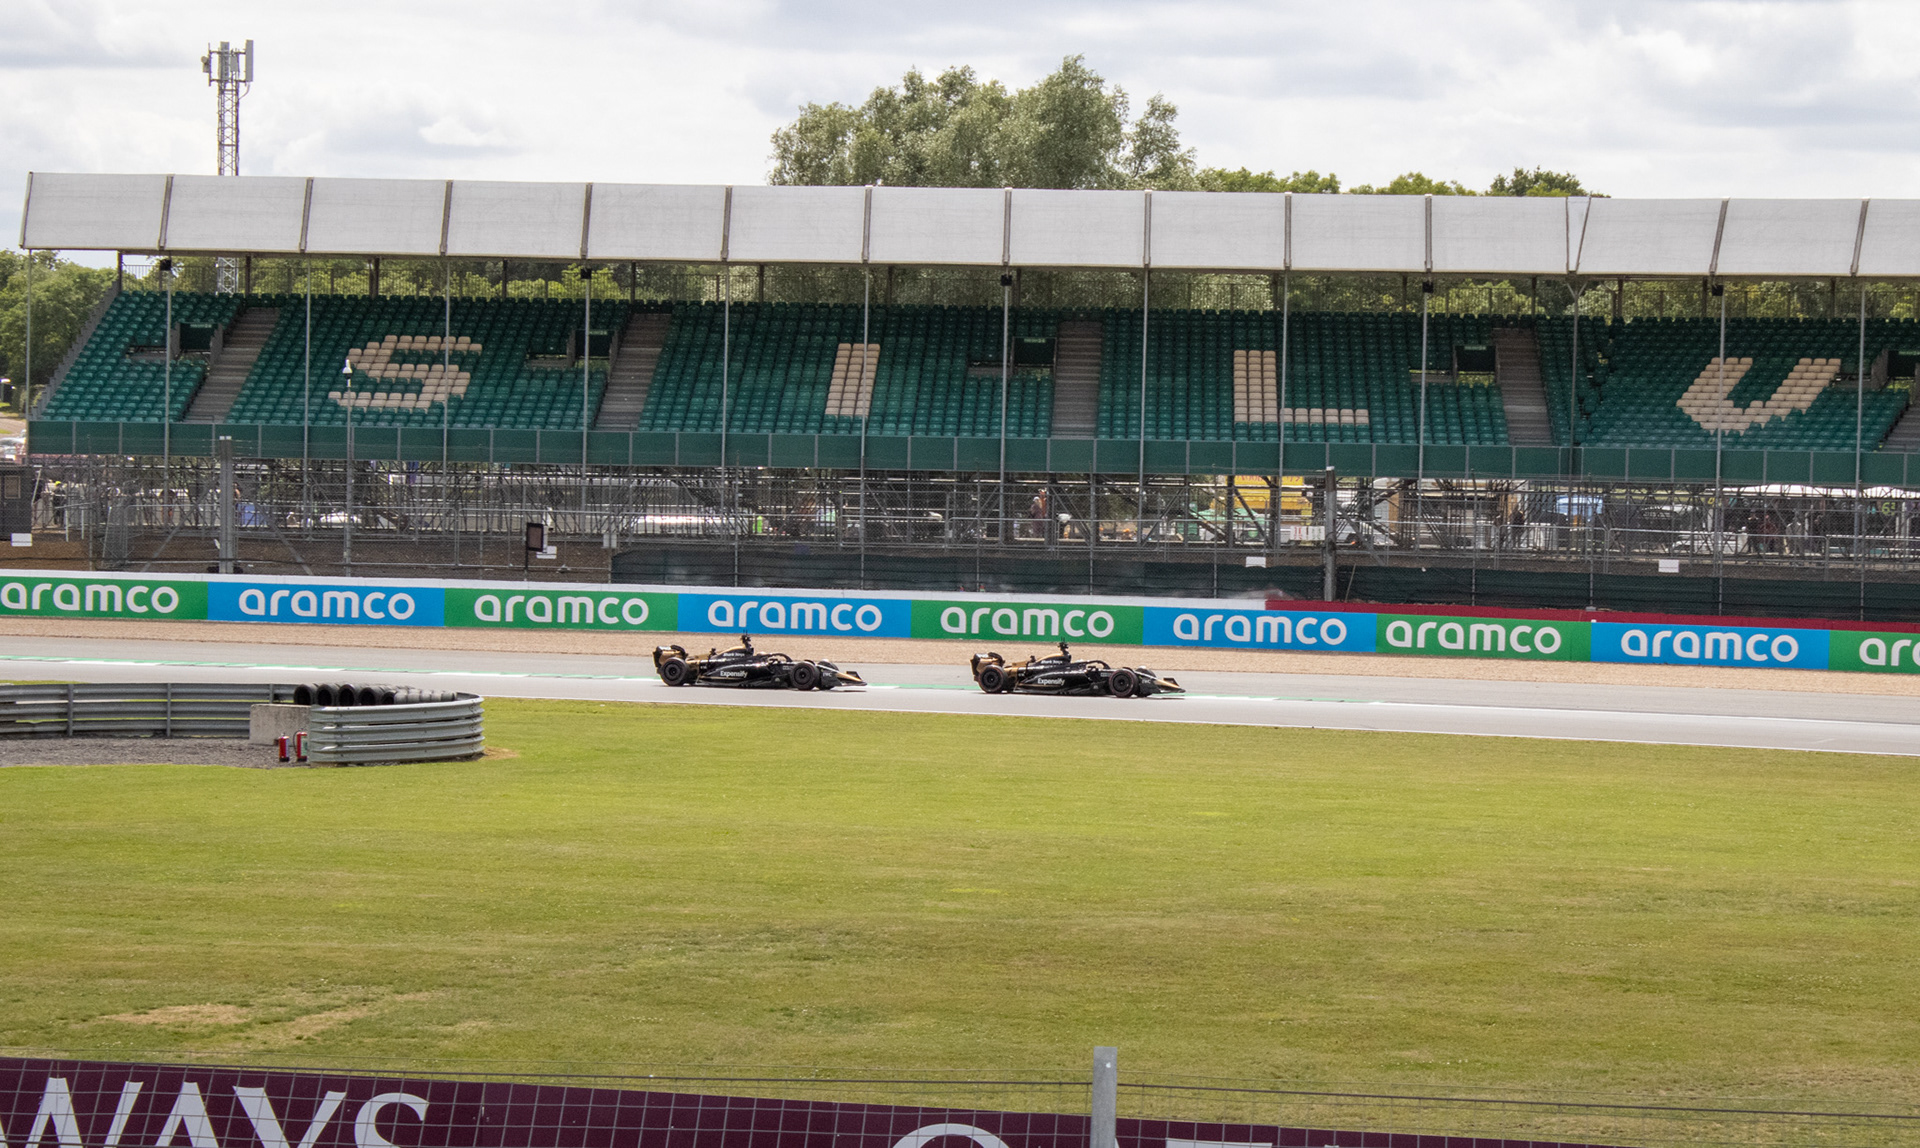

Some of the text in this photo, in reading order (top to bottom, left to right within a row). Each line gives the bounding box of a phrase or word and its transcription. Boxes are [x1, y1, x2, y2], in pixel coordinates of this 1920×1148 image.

[0, 582, 179, 613] aramco
[238, 588, 416, 620] aramco
[474, 594, 649, 625] aramco
[707, 600, 882, 632] aramco
[940, 606, 1115, 638] aramco
[1173, 613, 1347, 646] aramco
[1385, 620, 1562, 654] aramco
[1621, 629, 1799, 663] aramco
[1859, 637, 1920, 668] ar
[720, 670, 748, 679] Expensify
[1037, 677, 1066, 686] Expensify
